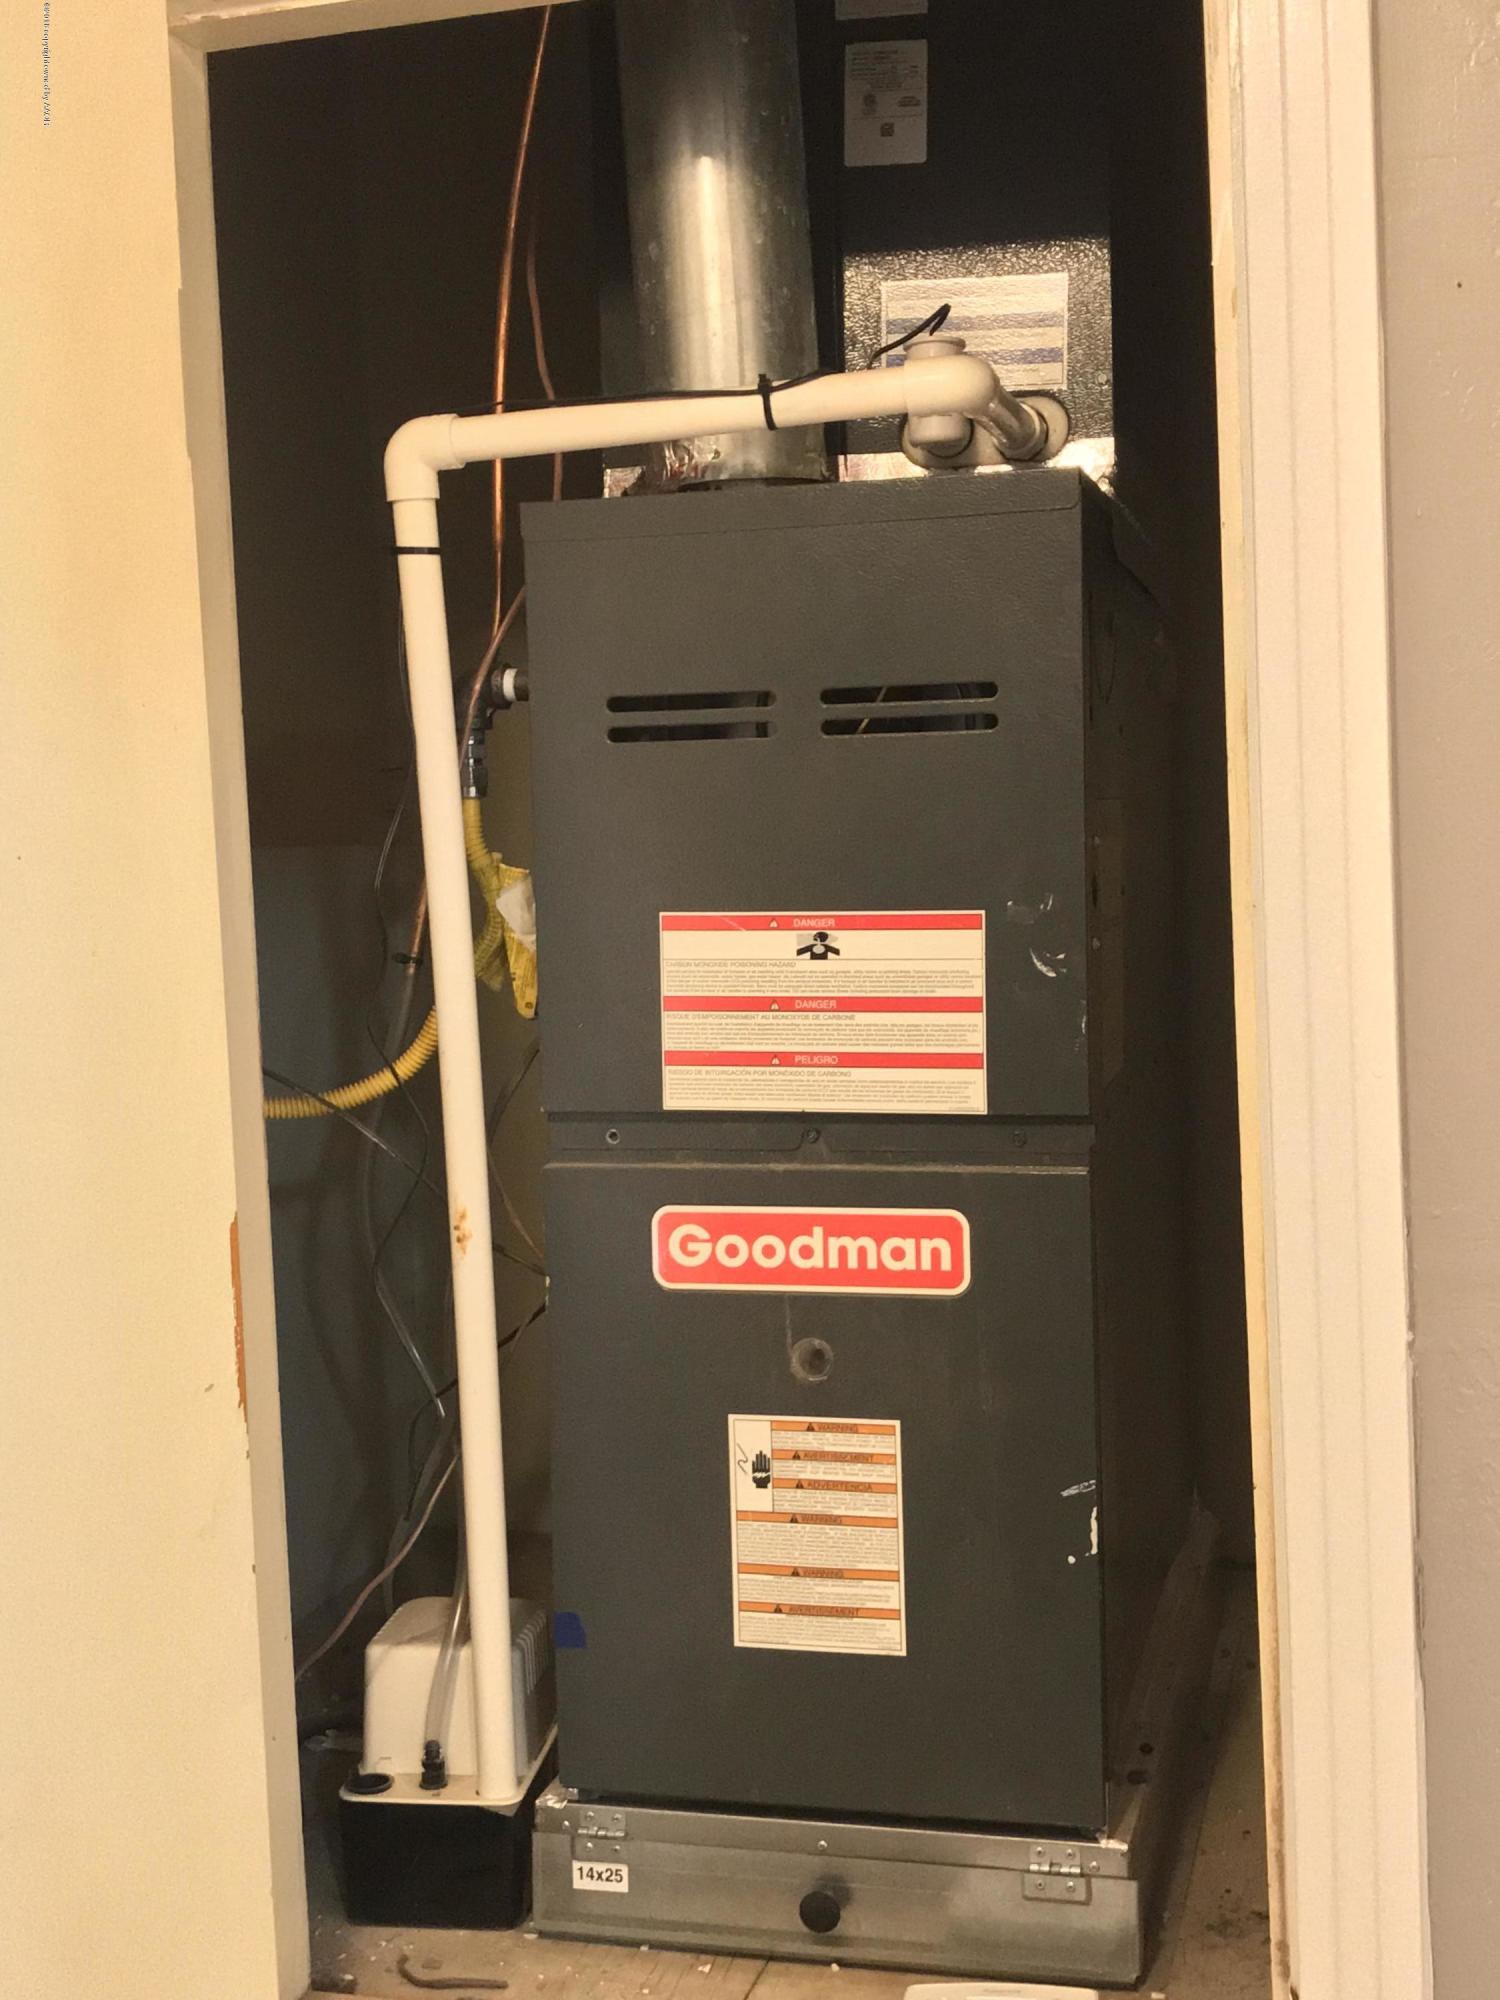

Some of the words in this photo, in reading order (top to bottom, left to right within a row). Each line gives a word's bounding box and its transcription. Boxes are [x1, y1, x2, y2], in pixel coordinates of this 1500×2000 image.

[793, 918, 835, 928] DANGER
[795, 999, 837, 1009] DANGER
[795, 1055, 838, 1065] PELIGRO
[753, 1069, 768, 1077] POR
[668, 1223, 952, 1272] Goodman
[817, 1423, 859, 1433] WARNING
[801, 1514, 842, 1524] WARNING
[802, 1567, 844, 1577] WARNING
[577, 1866, 624, 1883] 14x25
